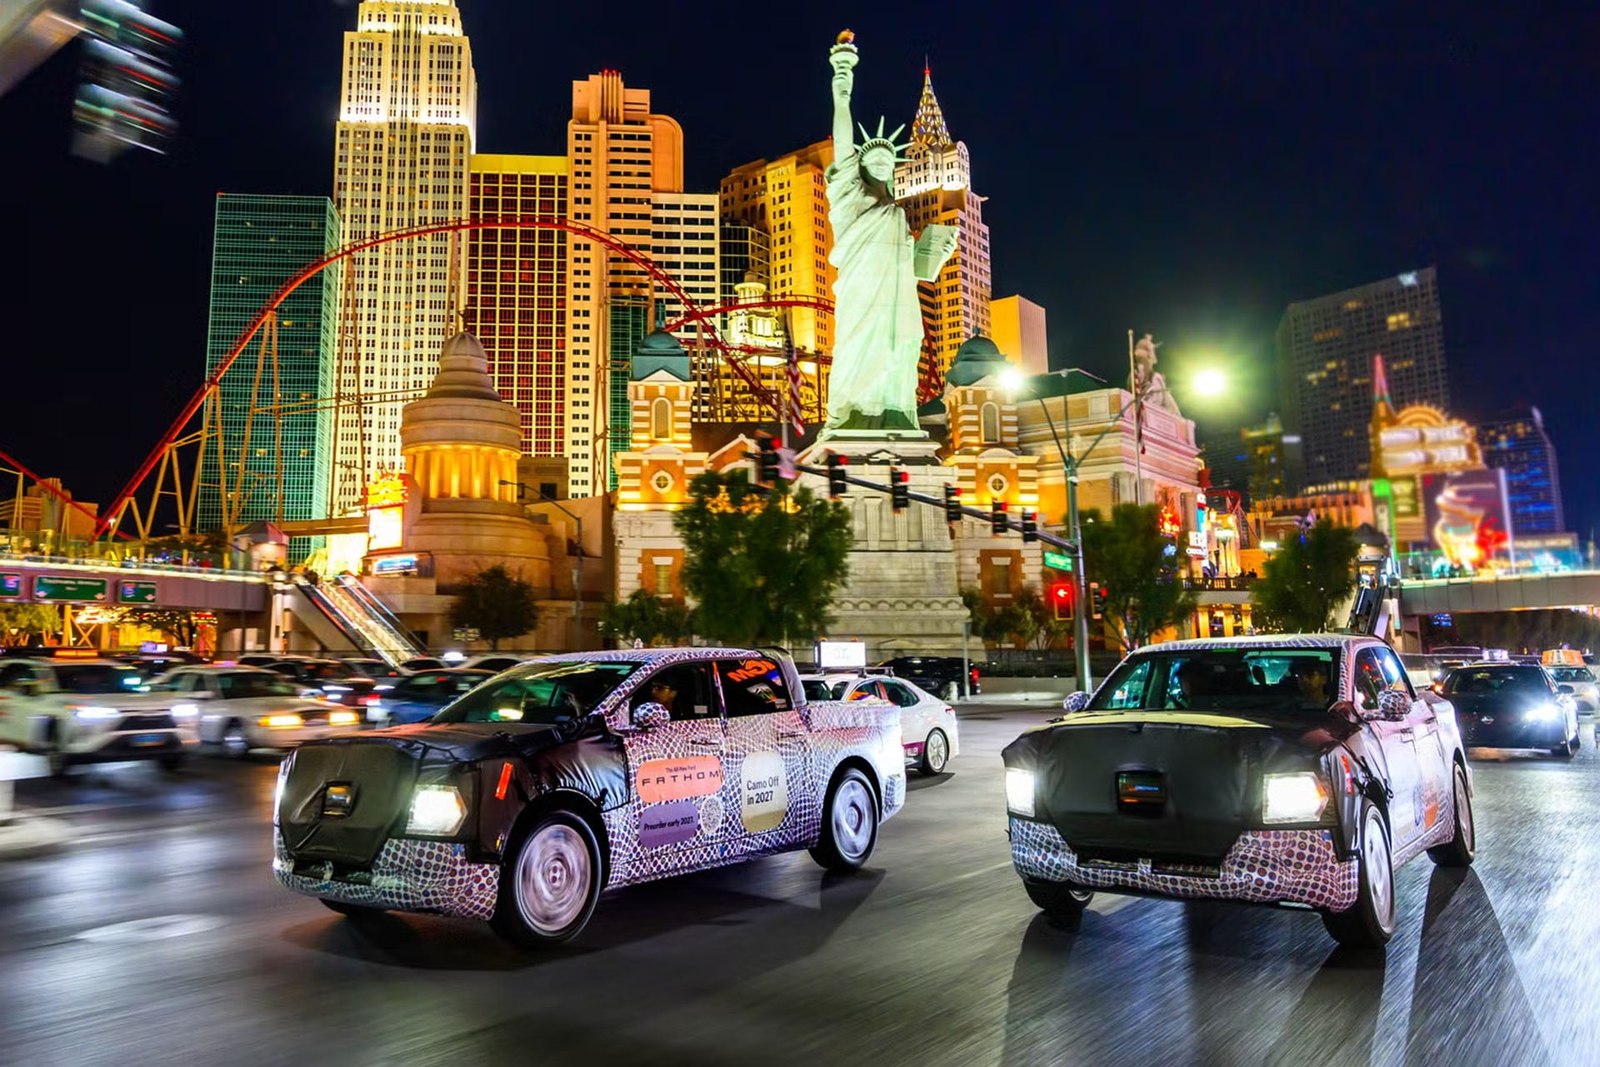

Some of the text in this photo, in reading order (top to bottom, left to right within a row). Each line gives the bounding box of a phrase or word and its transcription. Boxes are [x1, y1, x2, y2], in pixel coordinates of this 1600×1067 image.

[642, 770, 719, 786] FATHOM
[747, 776, 779, 790] Camo Off
[747, 791, 773, 805] in 2027
[643, 821, 667, 831] Preorder
[667, 819, 680, 828] early
